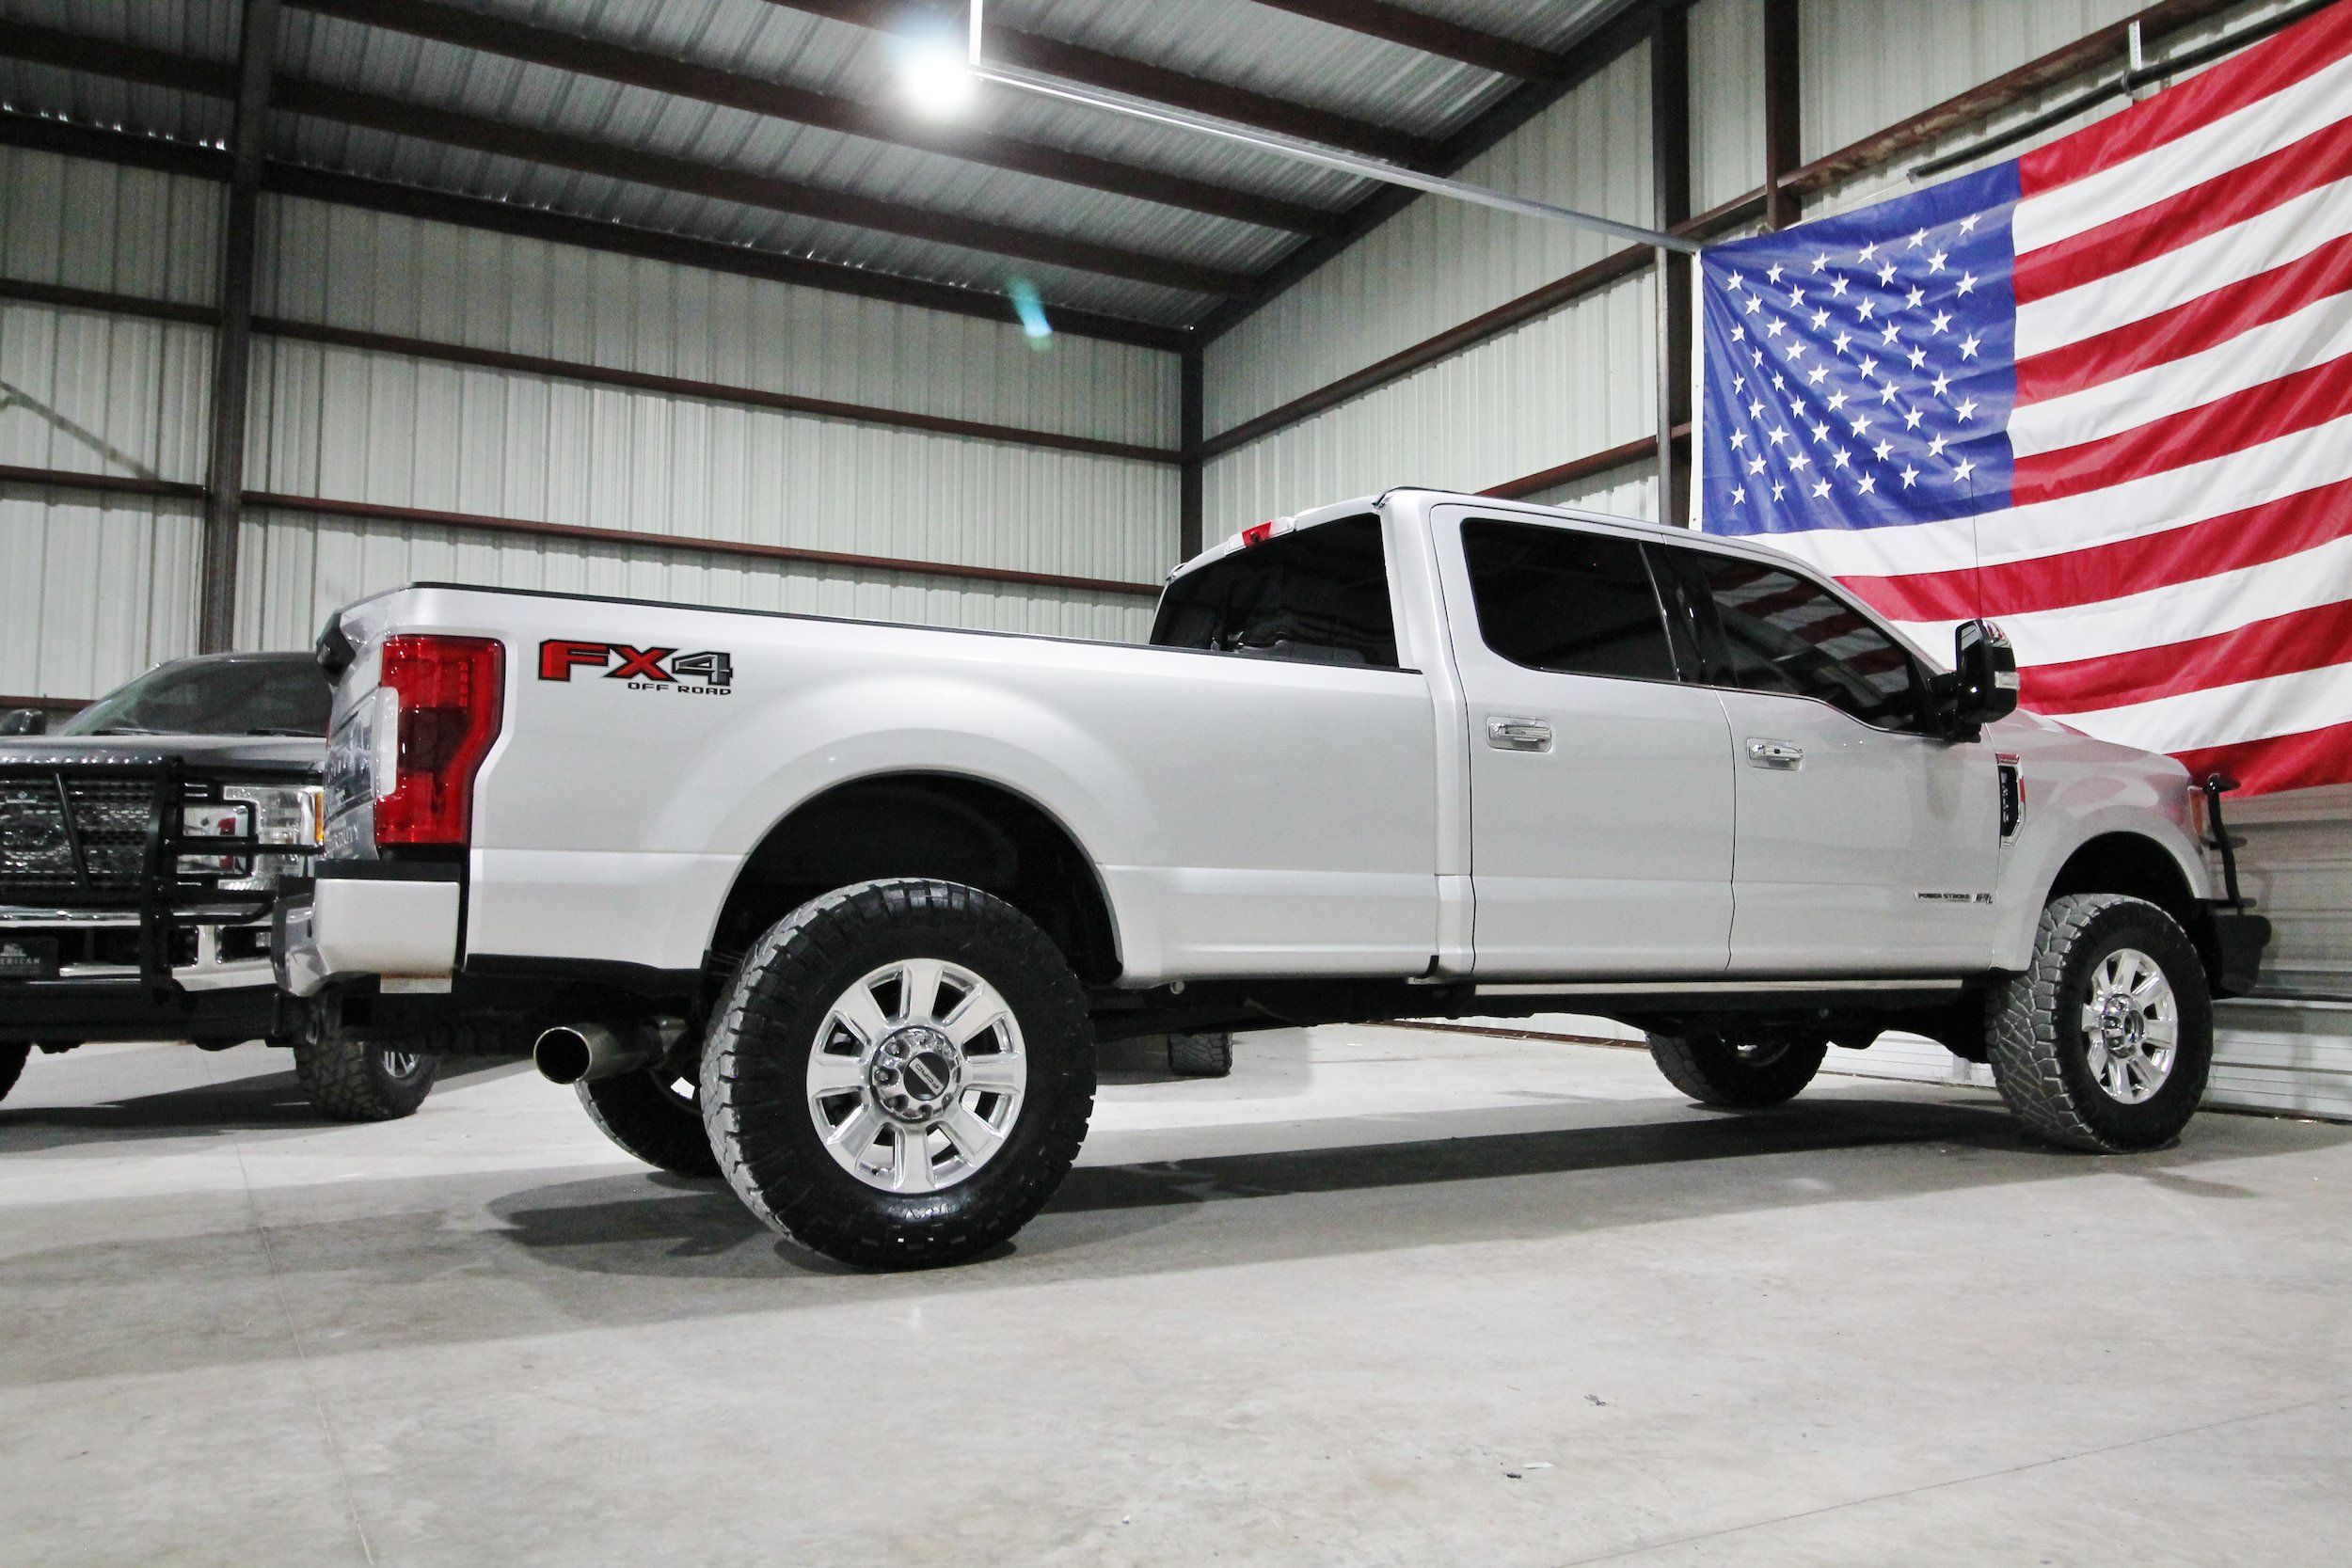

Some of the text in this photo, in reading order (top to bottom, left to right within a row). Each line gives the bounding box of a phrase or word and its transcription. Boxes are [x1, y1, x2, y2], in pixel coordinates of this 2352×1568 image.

[538, 639, 733, 687] FX4
[628, 682, 732, 695] OFF ROAD
